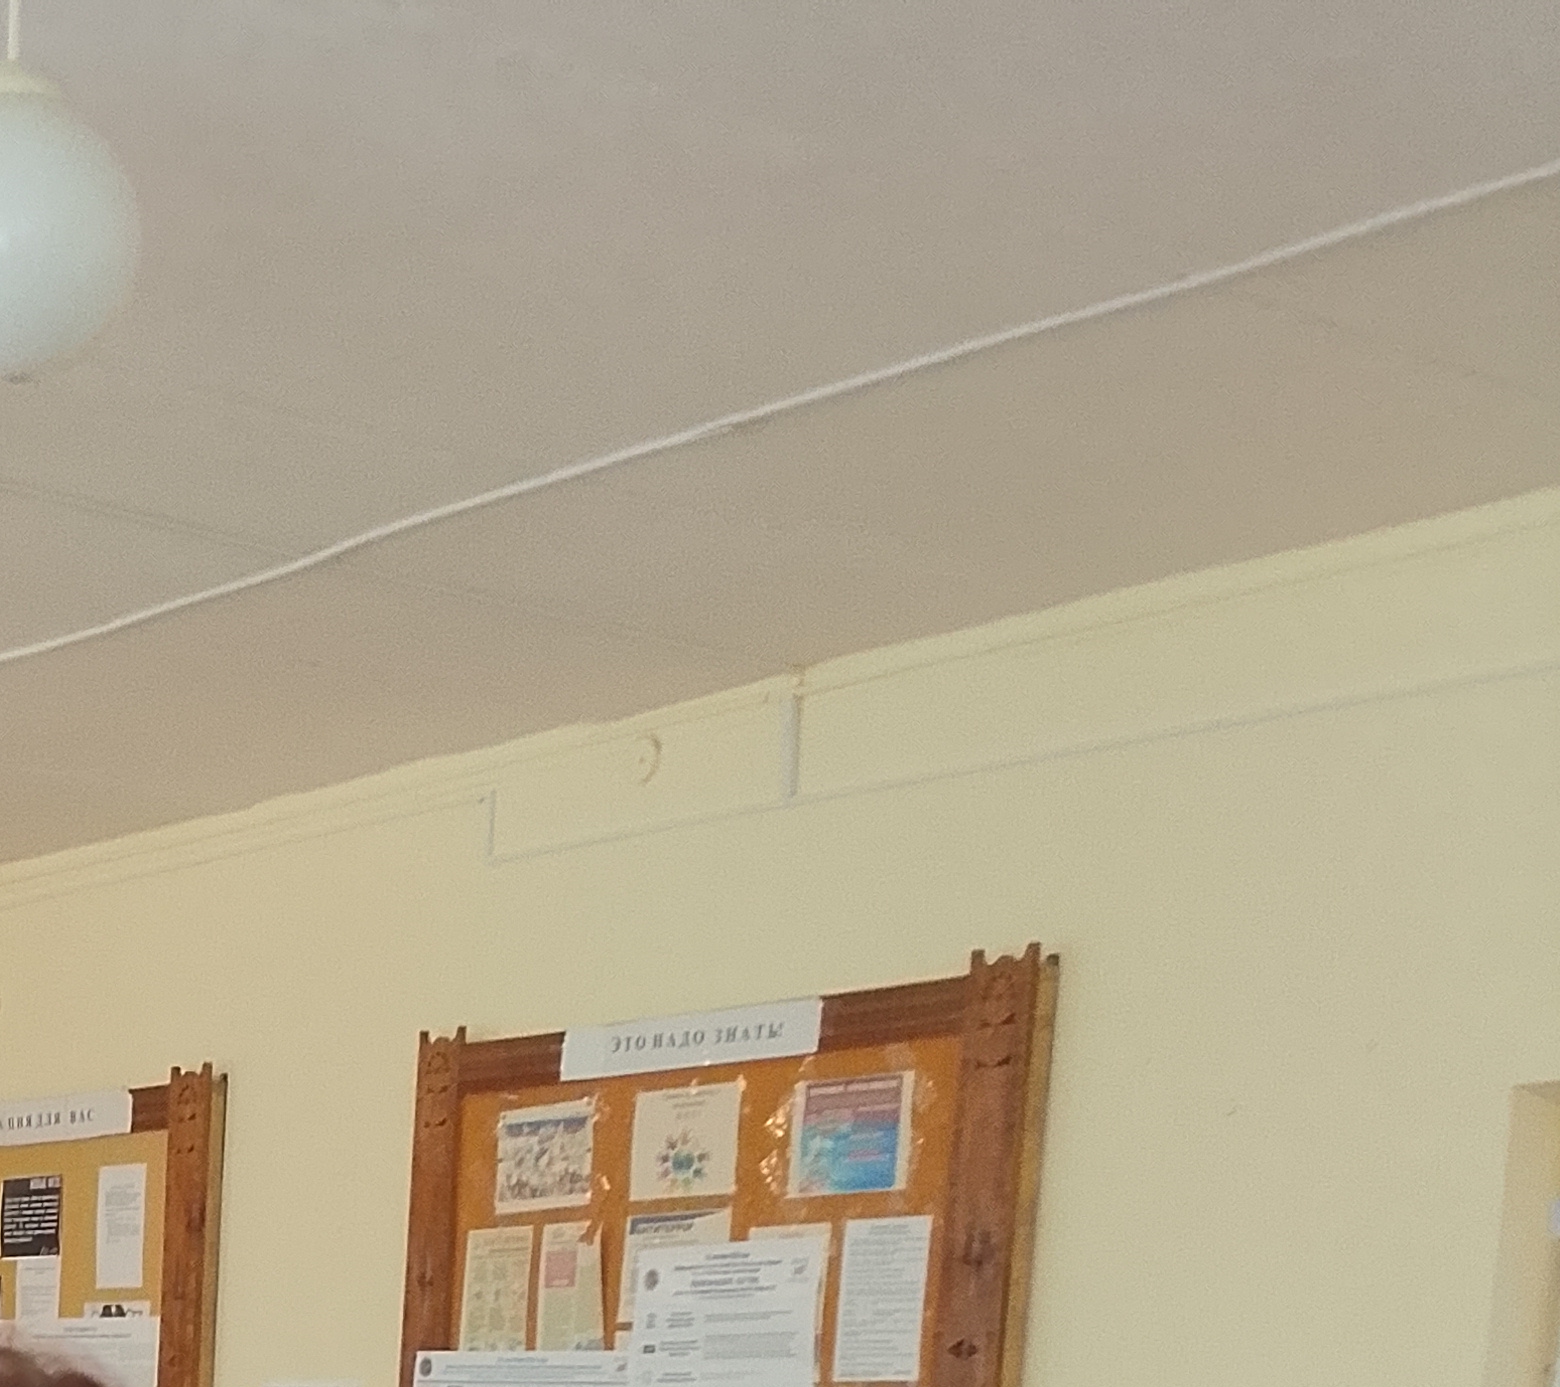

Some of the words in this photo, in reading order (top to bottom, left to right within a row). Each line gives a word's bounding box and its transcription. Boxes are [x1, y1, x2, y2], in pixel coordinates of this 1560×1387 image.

[611, 1034, 646, 1053] ЭТО
[651, 1028, 705, 1048] НАДО
[34, 1112, 62, 1129] ДЛЯ
[69, 1109, 96, 1125] ВАС
